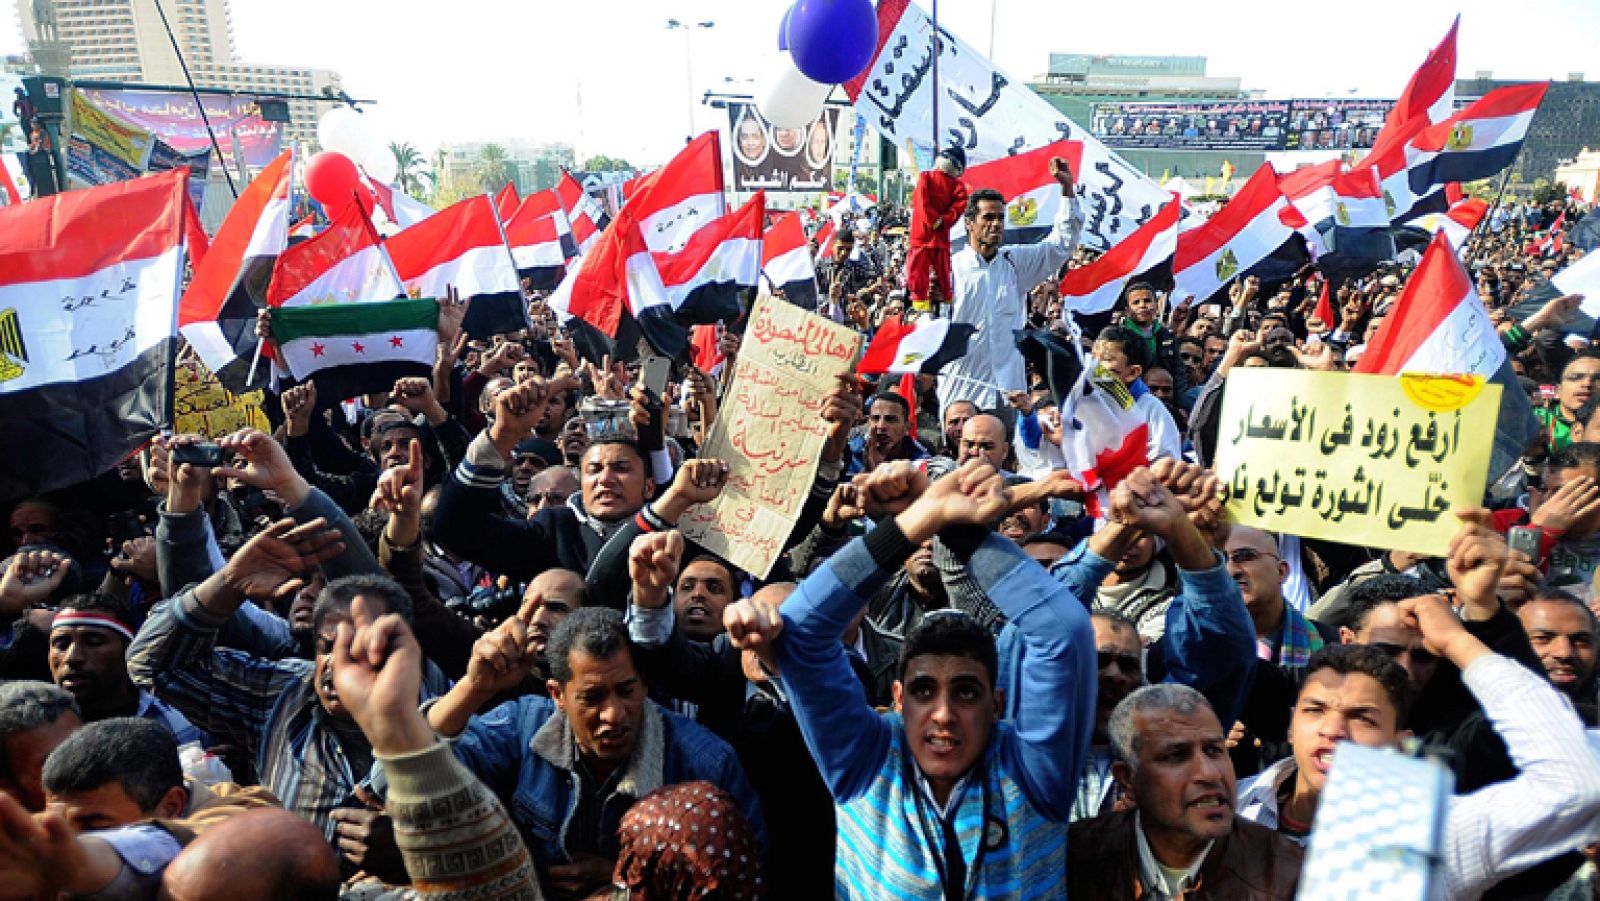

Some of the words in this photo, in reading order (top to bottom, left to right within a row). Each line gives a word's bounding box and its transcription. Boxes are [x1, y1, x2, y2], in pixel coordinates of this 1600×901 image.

[1231, 395, 1316, 445] الأسعار
[1360, 406, 1400, 459] زود
[1405, 408, 1461, 467] أرفع
[1220, 463, 1248, 507] نار
[1254, 467, 1305, 516] تولع
[1310, 464, 1384, 522] الثورة
